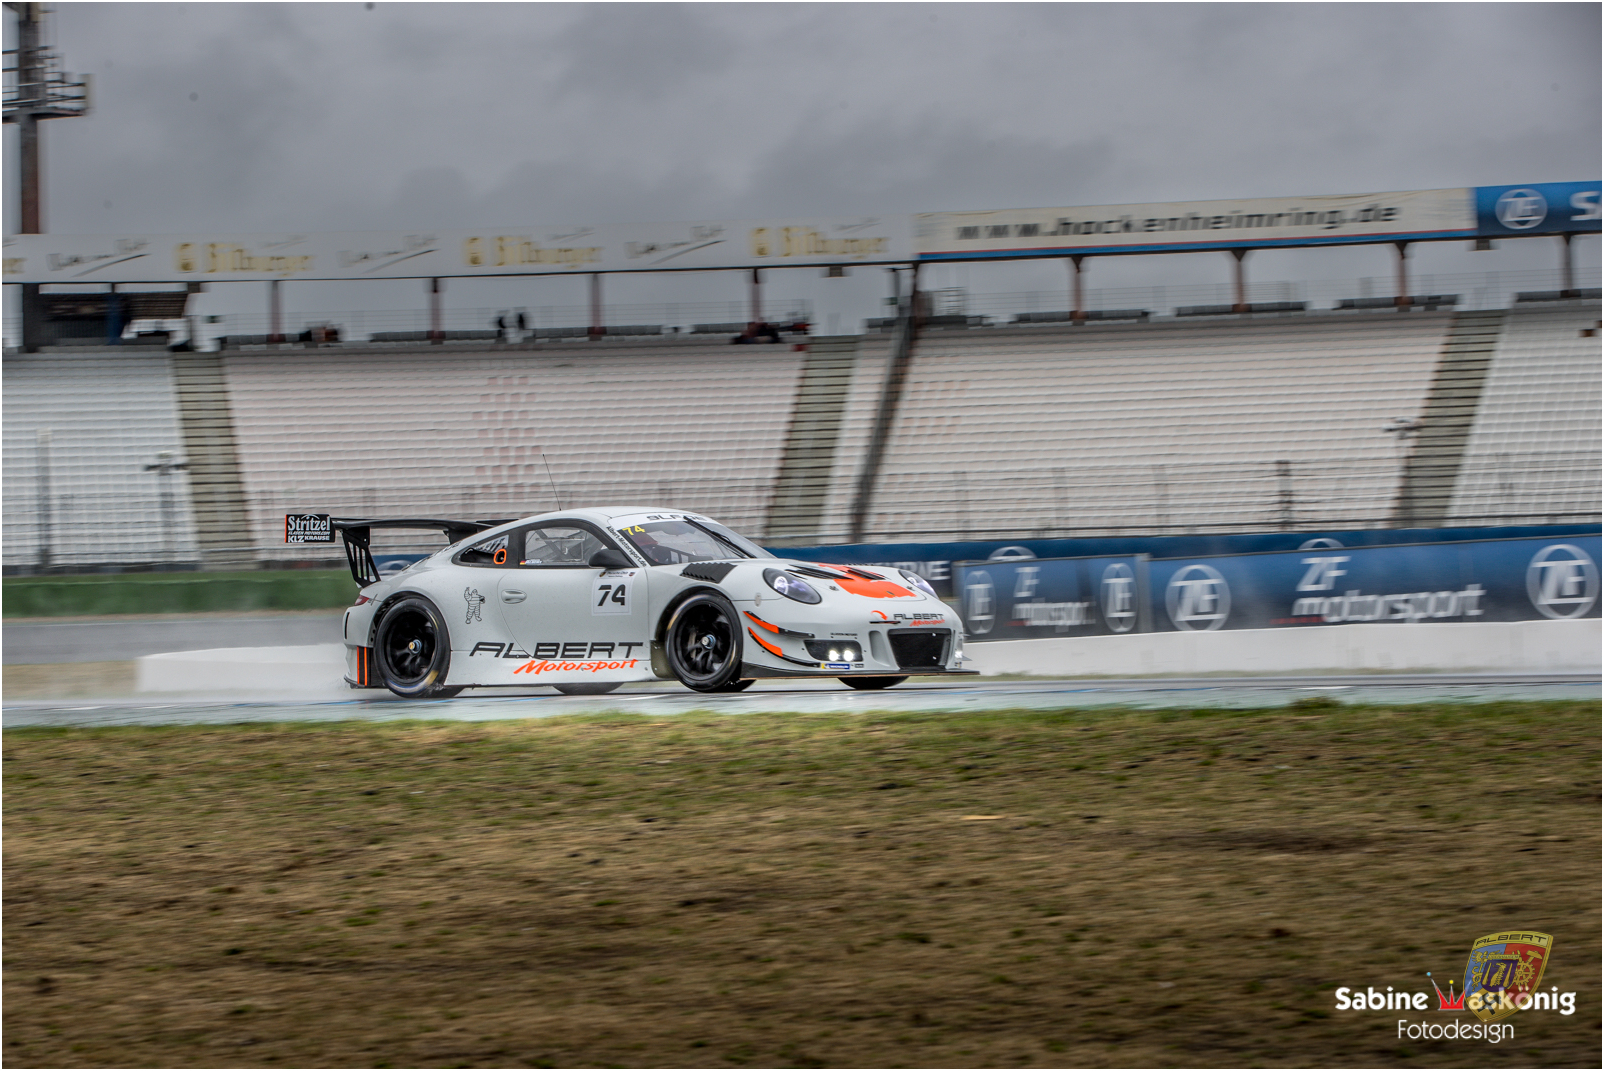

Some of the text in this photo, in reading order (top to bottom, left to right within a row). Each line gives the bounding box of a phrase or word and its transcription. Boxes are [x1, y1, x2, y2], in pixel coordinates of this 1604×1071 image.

[957, 203, 1400, 240] www.hockenheimring.de
[288, 515, 331, 531] Stritzel
[622, 525, 646, 536] 74
[288, 535, 305, 543] KLZ
[1296, 556, 1351, 591] ZF
[597, 584, 626, 607] 74
[1291, 584, 1487, 623] motorsport
[469, 641, 644, 659] ALBERT
[513, 659, 639, 675] Motorsport
